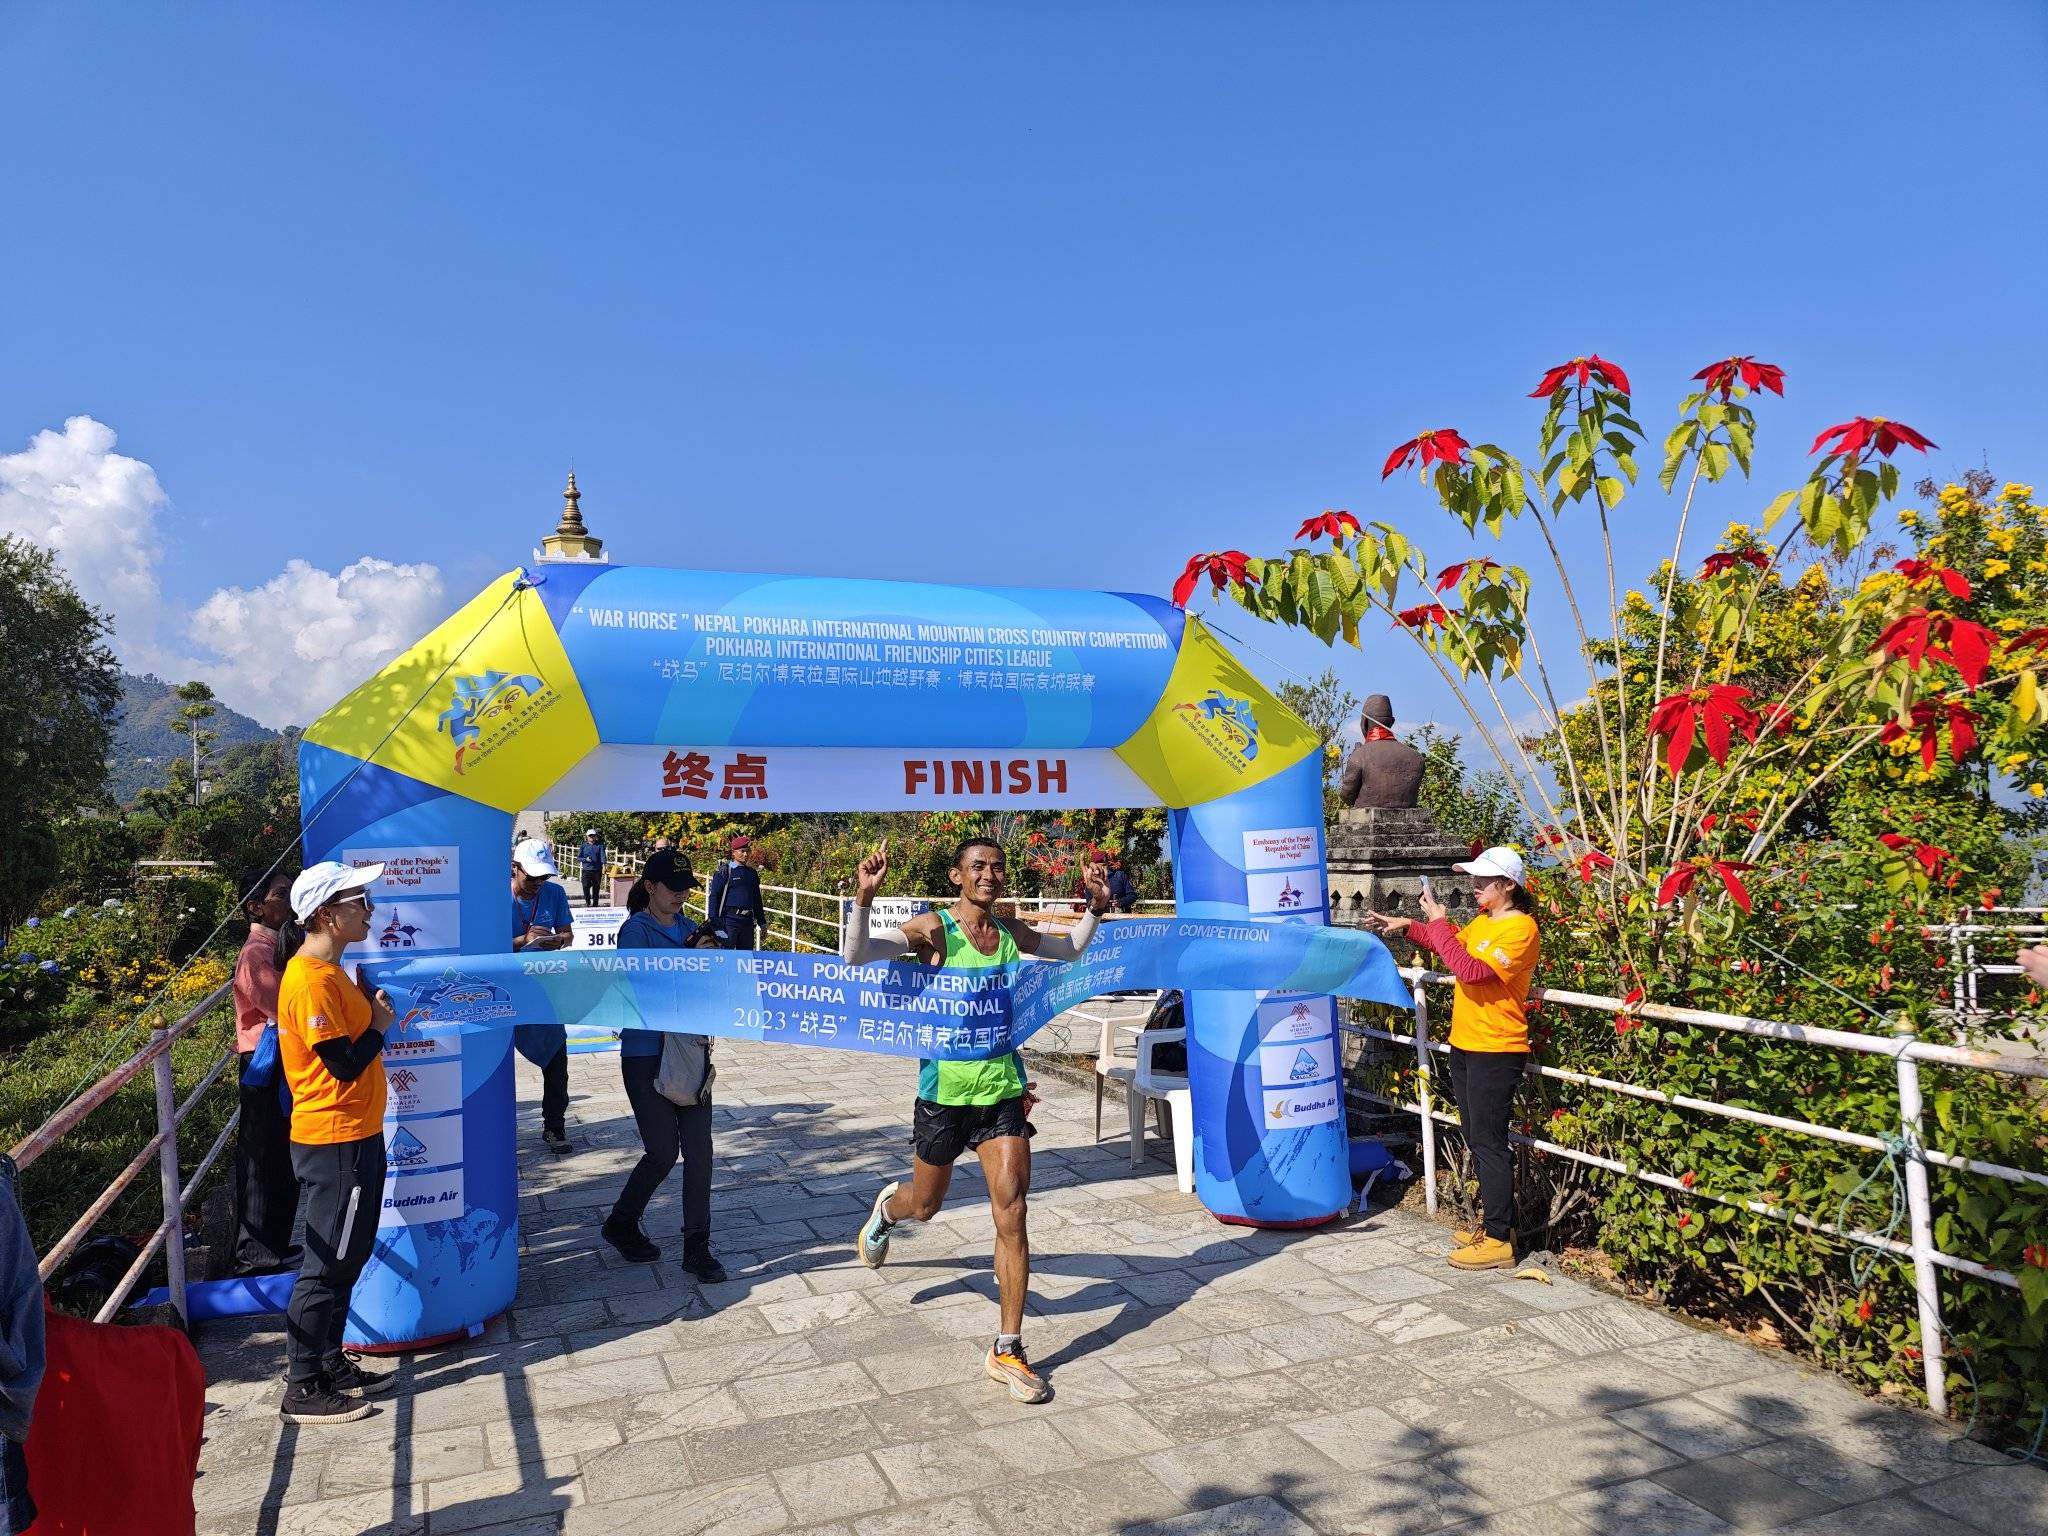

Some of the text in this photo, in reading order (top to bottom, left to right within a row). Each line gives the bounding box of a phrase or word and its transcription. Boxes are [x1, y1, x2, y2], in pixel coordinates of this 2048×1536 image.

[694, 614, 740, 633] NEPAL
[743, 616, 809, 637] POKHARA
[812, 619, 915, 641] INTERNATIONAL
[918, 624, 985, 644] MOUNTAIN
[988, 628, 1029, 647] CROSS
[1031, 629, 1087, 648] COUNTRY
[1089, 631, 1168, 650] COMPETITION
[705, 637, 1053, 668] POKHARA INTERNATIONAL FRIENDSHIP CITIES LEAGUE
[662, 751, 768, 799] 终点
[904, 760, 1069, 795] FINISH
[390, 858, 400, 866] of
[401, 858, 413, 866] the
[415, 856, 449, 868] People's
[406, 867, 414, 875] of
[416, 866, 441, 876] China
[386, 877, 422, 887] in Nepal
[870, 905, 881, 915] No
[883, 905, 896, 915] Tik
[897, 905, 910, 915] Tok
[870, 918, 882, 928] No
[380, 940, 412, 948] NTB
[588, 933, 604, 947] 38
[522, 959, 568, 976] 2023
[736, 958, 799, 978] NEPAL
[812, 962, 902, 989] POKHARA
[1113, 924, 1171, 940] COUNTRY
[1178, 924, 1271, 943] COMPETITION
[755, 981, 846, 1006] POKHARA
[859, 990, 1005, 1017] INTERNATIONAL
[1080, 946, 1122, 968] LEAGUE
[1294, 1098, 1336, 1113] Buddha Air
[384, 1191, 458, 1208] Buddha Air
